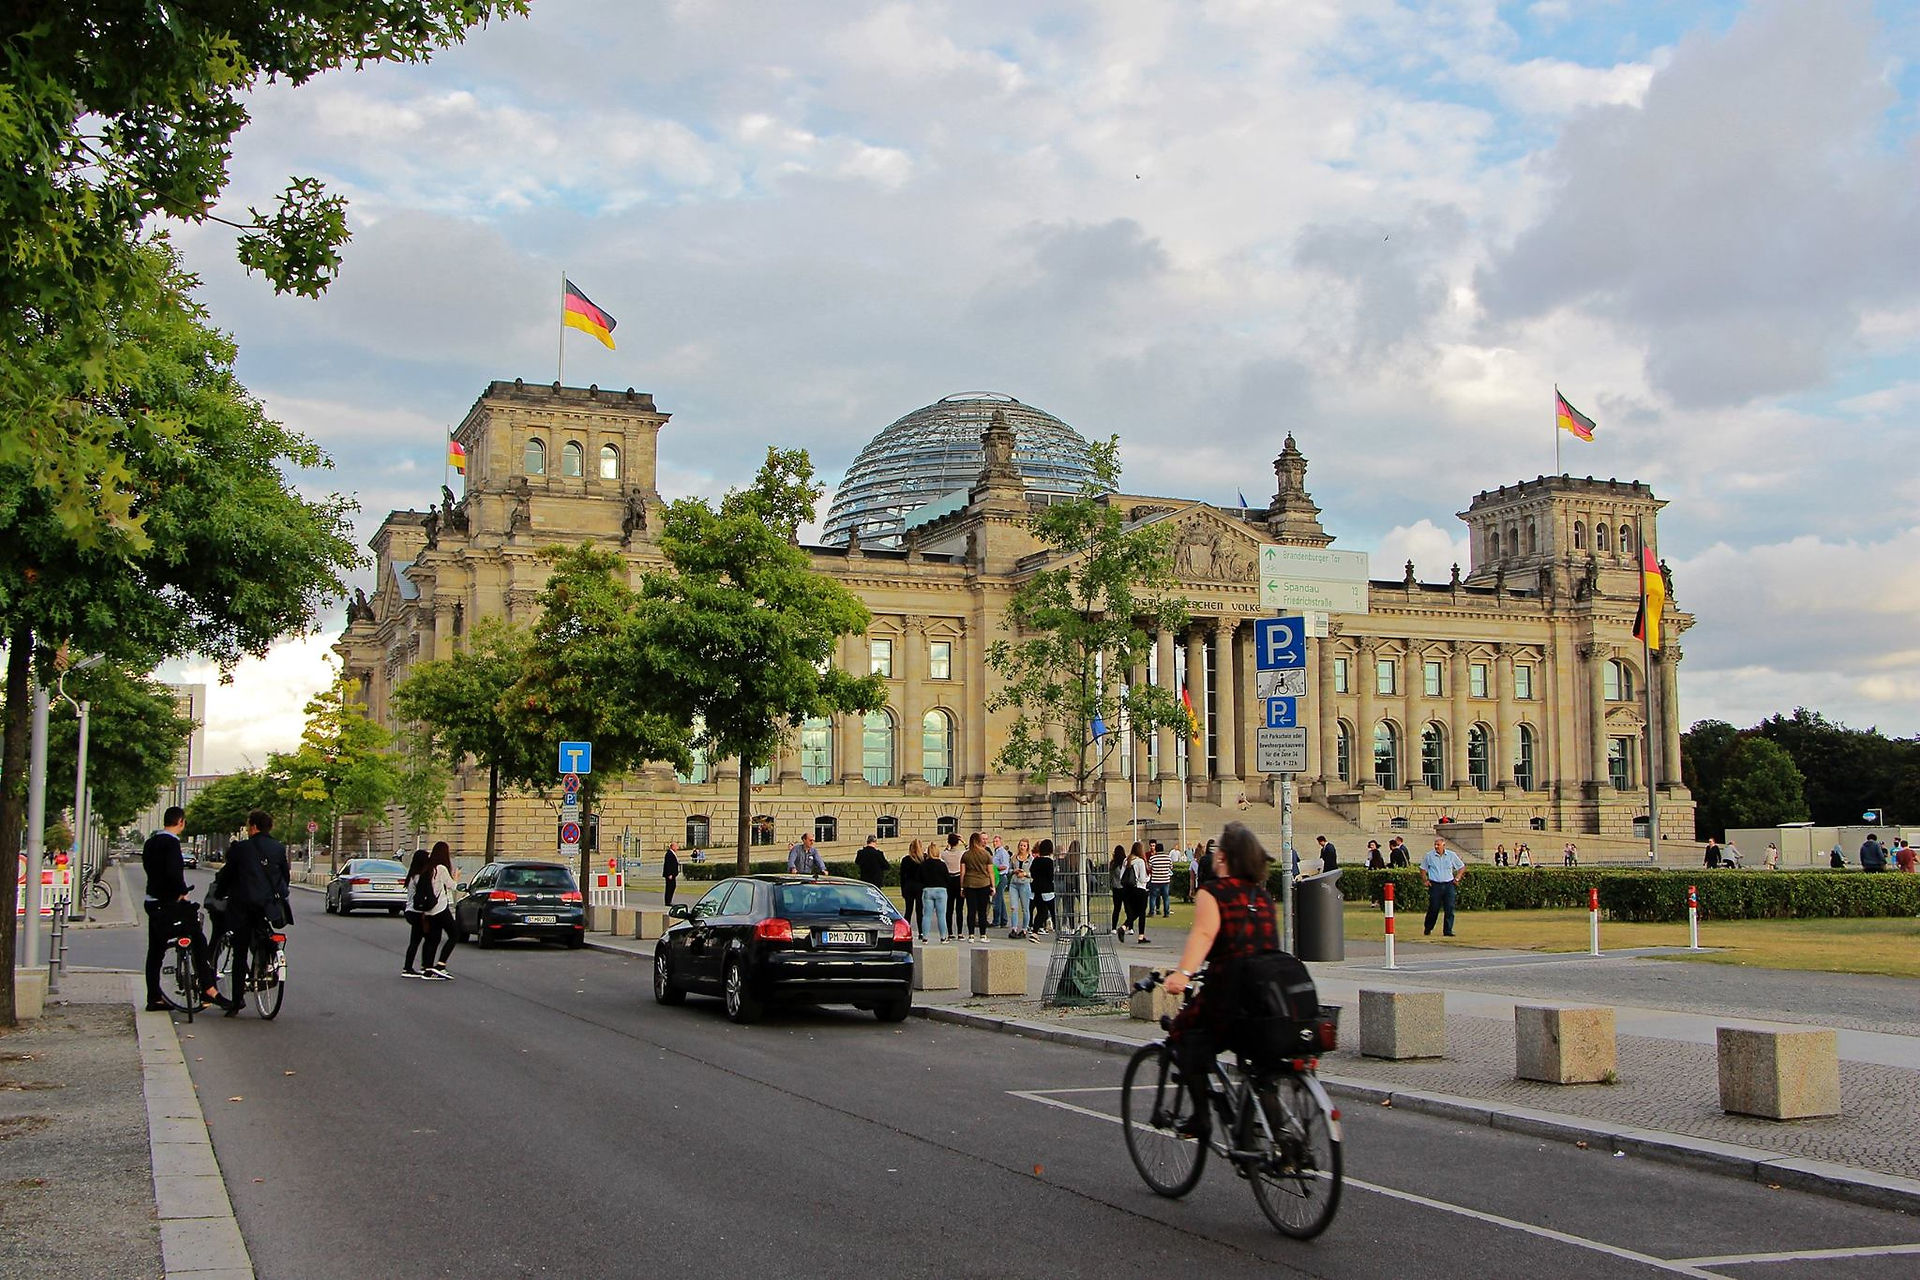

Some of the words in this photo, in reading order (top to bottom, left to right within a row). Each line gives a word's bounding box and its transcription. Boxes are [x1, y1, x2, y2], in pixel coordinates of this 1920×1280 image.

[1283, 551, 1328, 563] Brandenburger
[1330, 554, 1340, 563] Tor
[1284, 582, 1320, 593] Spandau
[1283, 595, 1332, 607] Friedrichstraße
[1267, 625, 1293, 664] P
[1271, 701, 1288, 725] P
[828, 932, 838, 941] PM
